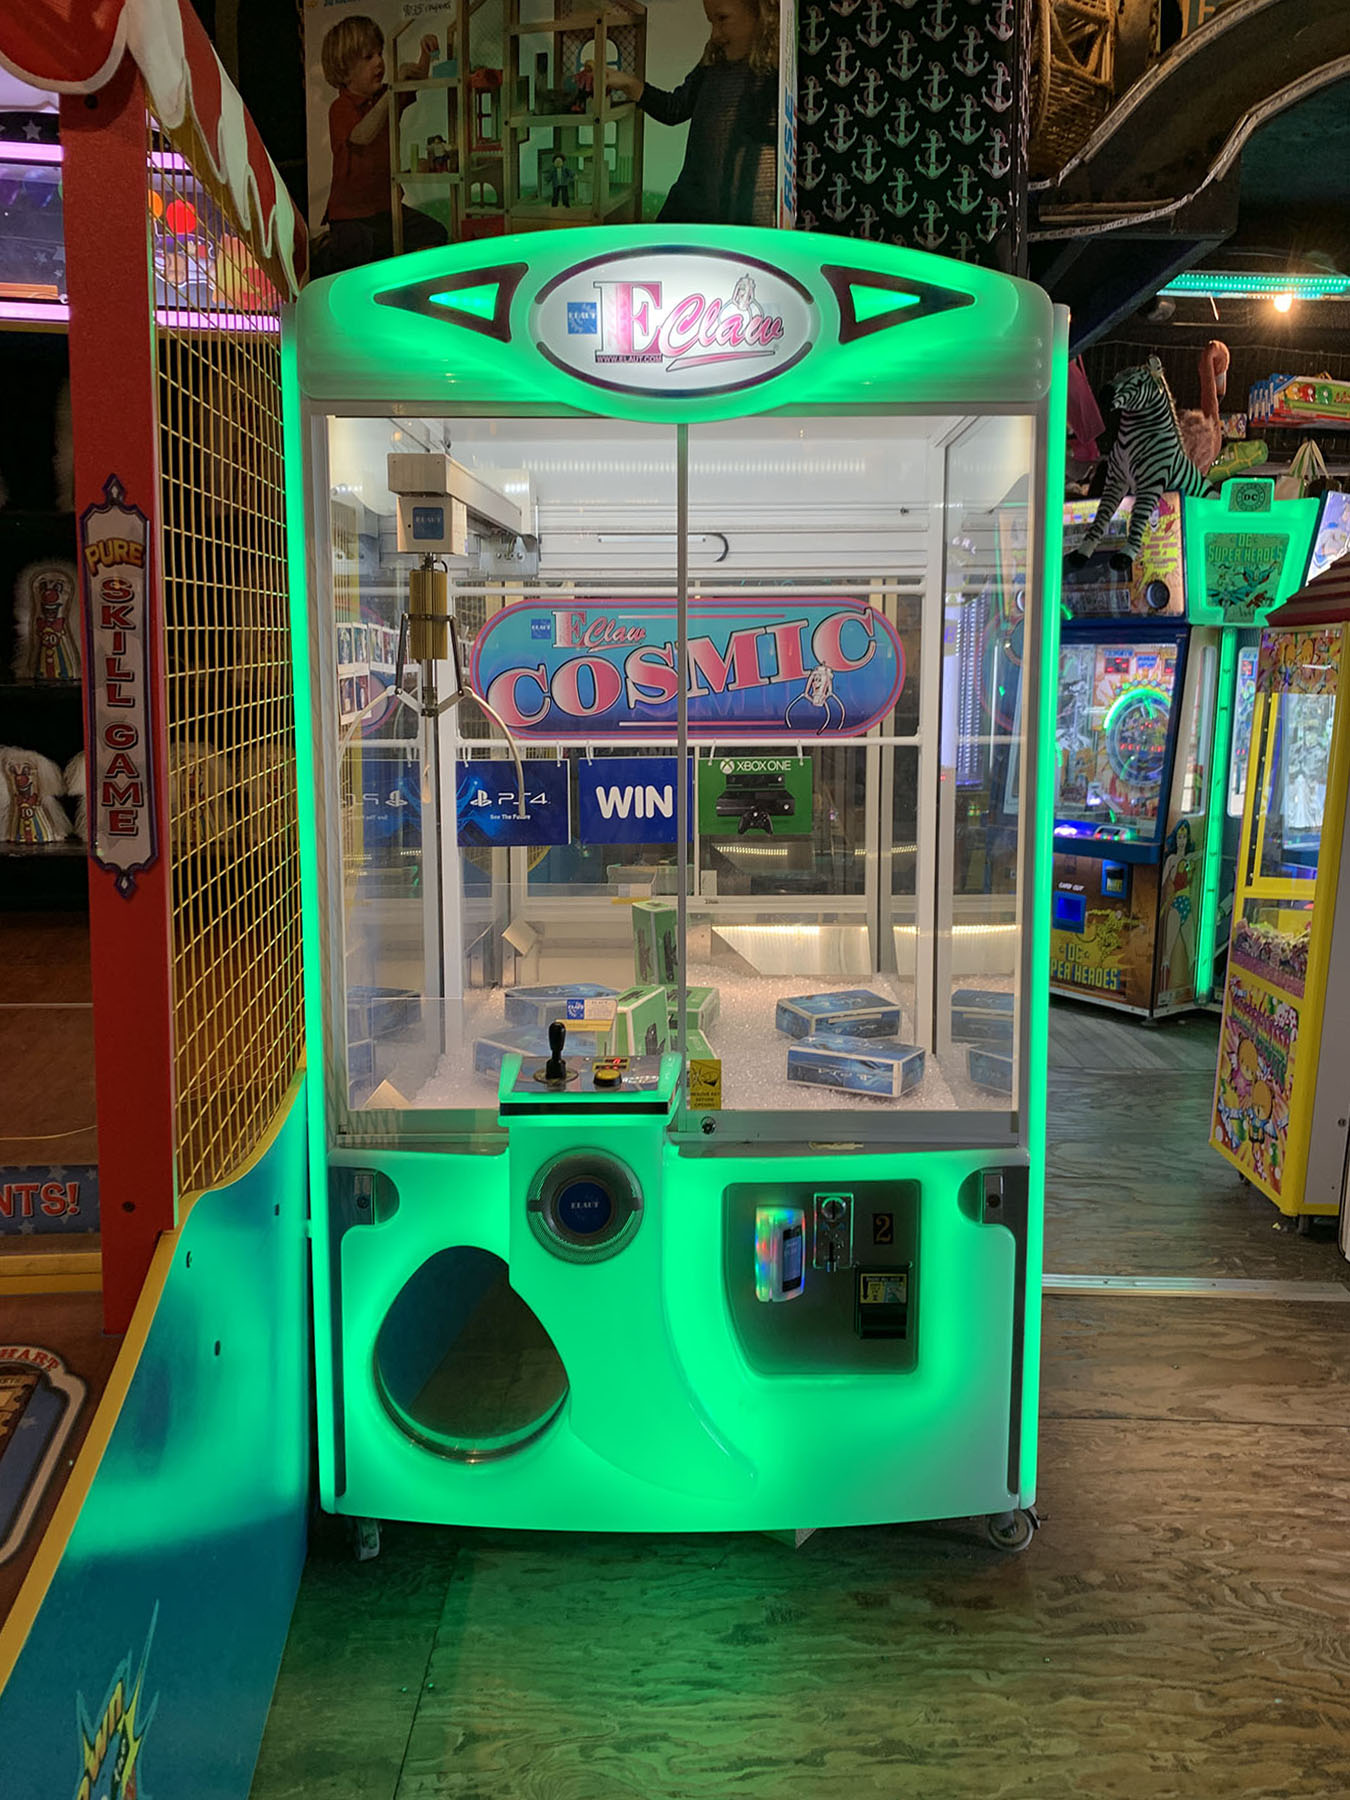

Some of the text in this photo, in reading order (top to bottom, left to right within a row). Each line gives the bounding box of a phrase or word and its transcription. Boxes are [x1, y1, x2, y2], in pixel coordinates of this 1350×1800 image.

[659, 293, 784, 357] Claw
[596, 355, 663, 363] WWW.ELAUT.COM
[1243, 493, 1258, 501] DC
[84, 537, 146, 576] PURE
[1208, 545, 1284, 563] SUPER HEROES
[43, 633, 57, 646] 20
[100, 577, 137, 708] SKILL
[584, 615, 647, 649] Claw
[487, 607, 876, 727] COSMIC
[736, 760, 791, 771] XBOX ONE
[101, 723, 145, 838] GAME
[498, 792, 549, 805] PS4
[596, 785, 674, 819] WIN
[1073, 965, 1120, 990] HEROES
[875, 1215, 892, 1242] 2
